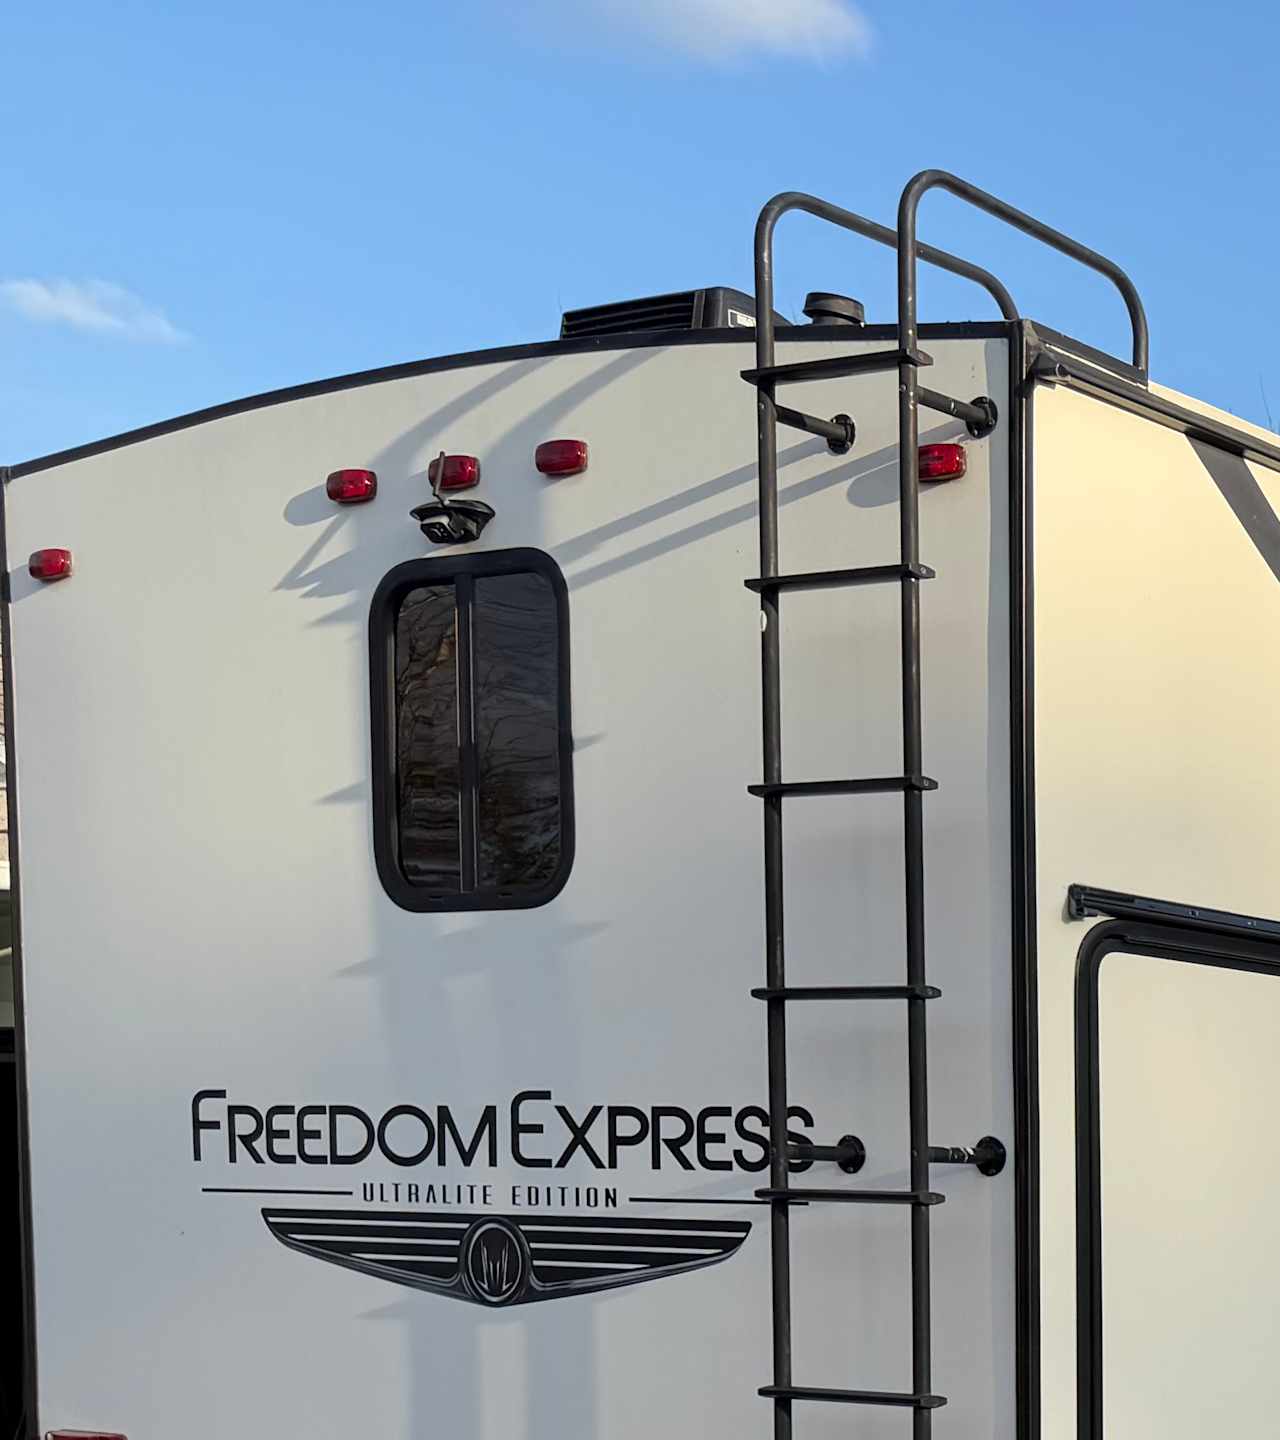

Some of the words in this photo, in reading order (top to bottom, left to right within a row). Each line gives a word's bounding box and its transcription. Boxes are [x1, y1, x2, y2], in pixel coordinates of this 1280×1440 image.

[191, 1088, 498, 1168] FREEDOM
[510, 1088, 815, 1174] EXPRESS
[362, 1182, 493, 1206] ULTRALITE
[511, 1185, 617, 1209] EDITION
